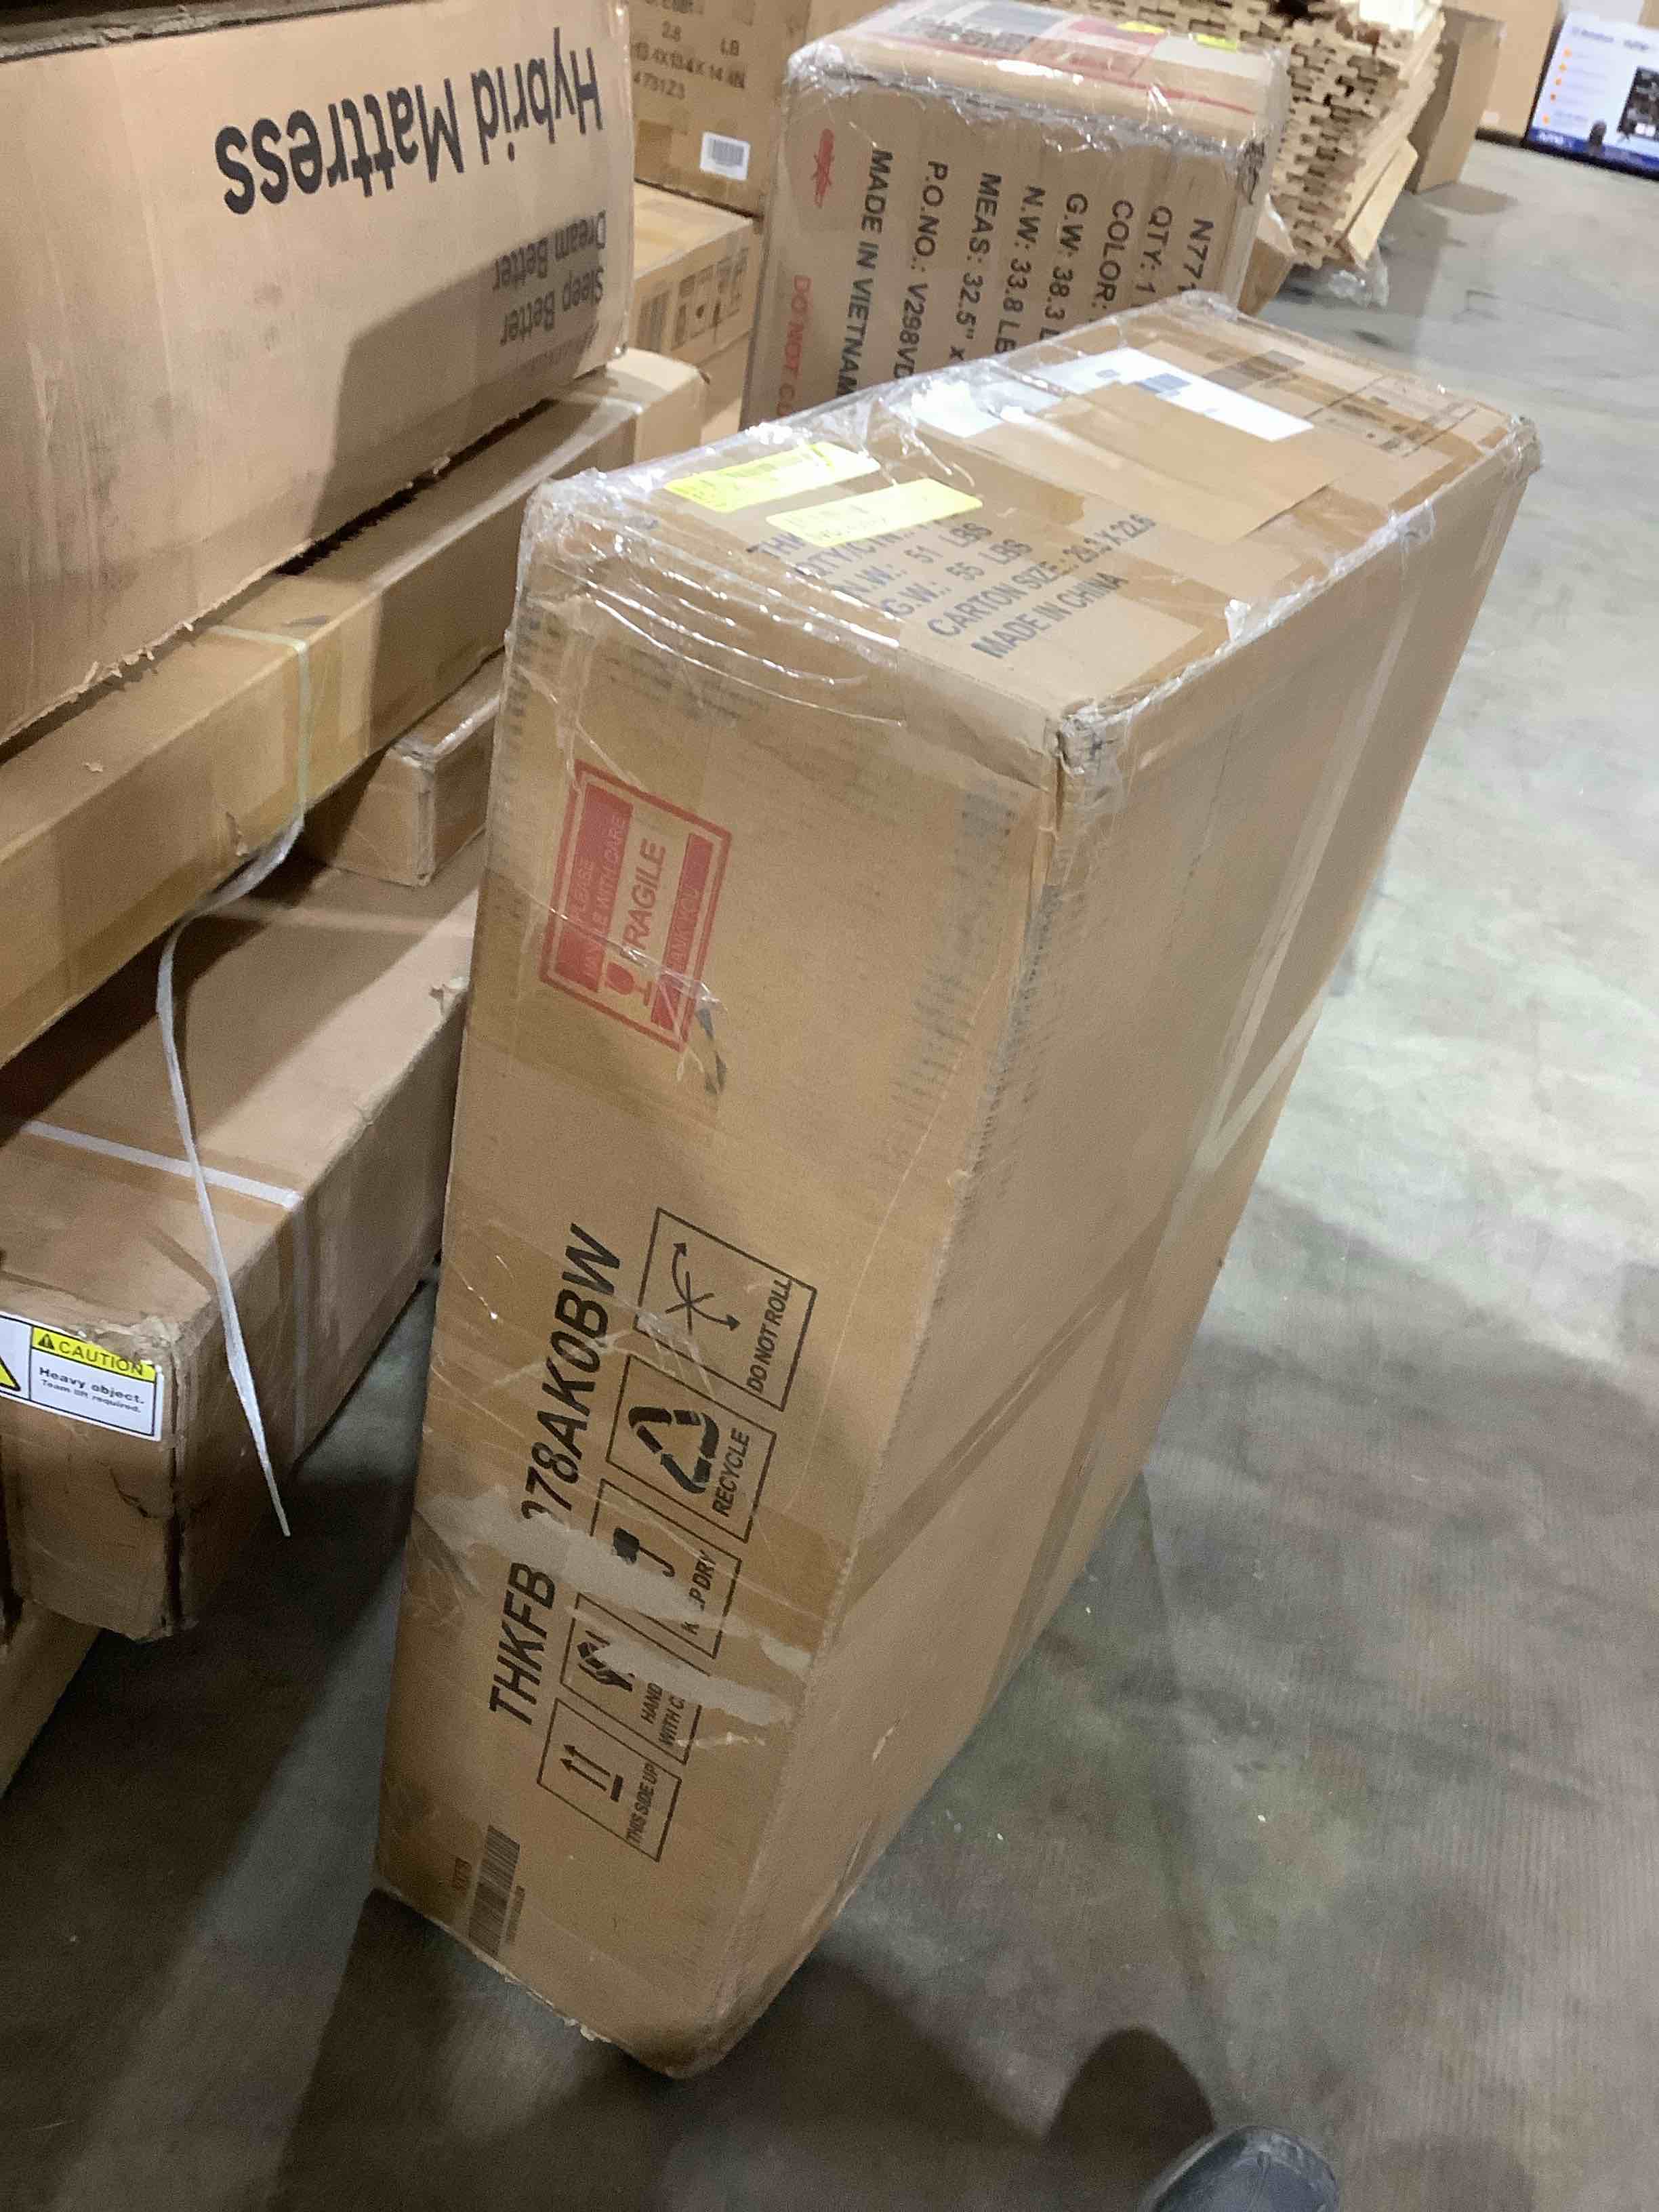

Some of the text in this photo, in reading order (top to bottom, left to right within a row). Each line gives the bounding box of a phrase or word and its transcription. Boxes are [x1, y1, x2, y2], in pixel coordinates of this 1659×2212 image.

[215, 27, 602, 214] Hybrid Mattress
[492, 211, 607, 291] Dream Better
[966, 172, 1002, 262] MEAS:
[1090, 201, 1133, 309] COLOR:
[1139, 205, 1172, 271] QTY:
[500, 266, 605, 346] Sleep Better
[792, 275, 812, 313] DO
[836, 148, 893, 397] MADE IN VIETNAM
[1002, 258, 1032, 314] 33.8
[1044, 266, 1073, 321] 38.3
[785, 321, 806, 380] NOT
[938, 522, 993, 548] LBS
[945, 561, 985, 581] 55
[978, 538, 1033, 565] LBS
[927, 581, 1028, 636] CARTON
[970, 571, 1130, 659] MADE IN CHINA
[619, 838, 666, 963] FRAGILE
[59, 1341, 144, 1375] CAUTION
[747, 1279, 792, 1394] DO NOT ROLL
[39, 1366, 144, 1405] Heavy object.
[712, 1427, 750, 1517] RECYCLE
[681, 1549, 716, 1635] KP DRY
[488, 1563, 555, 1725] THKFB
[641, 1682, 663, 1724] HAND
[659, 1708, 682, 1746] WITH
[626, 1763, 658, 1843] THIS SIDE UP
